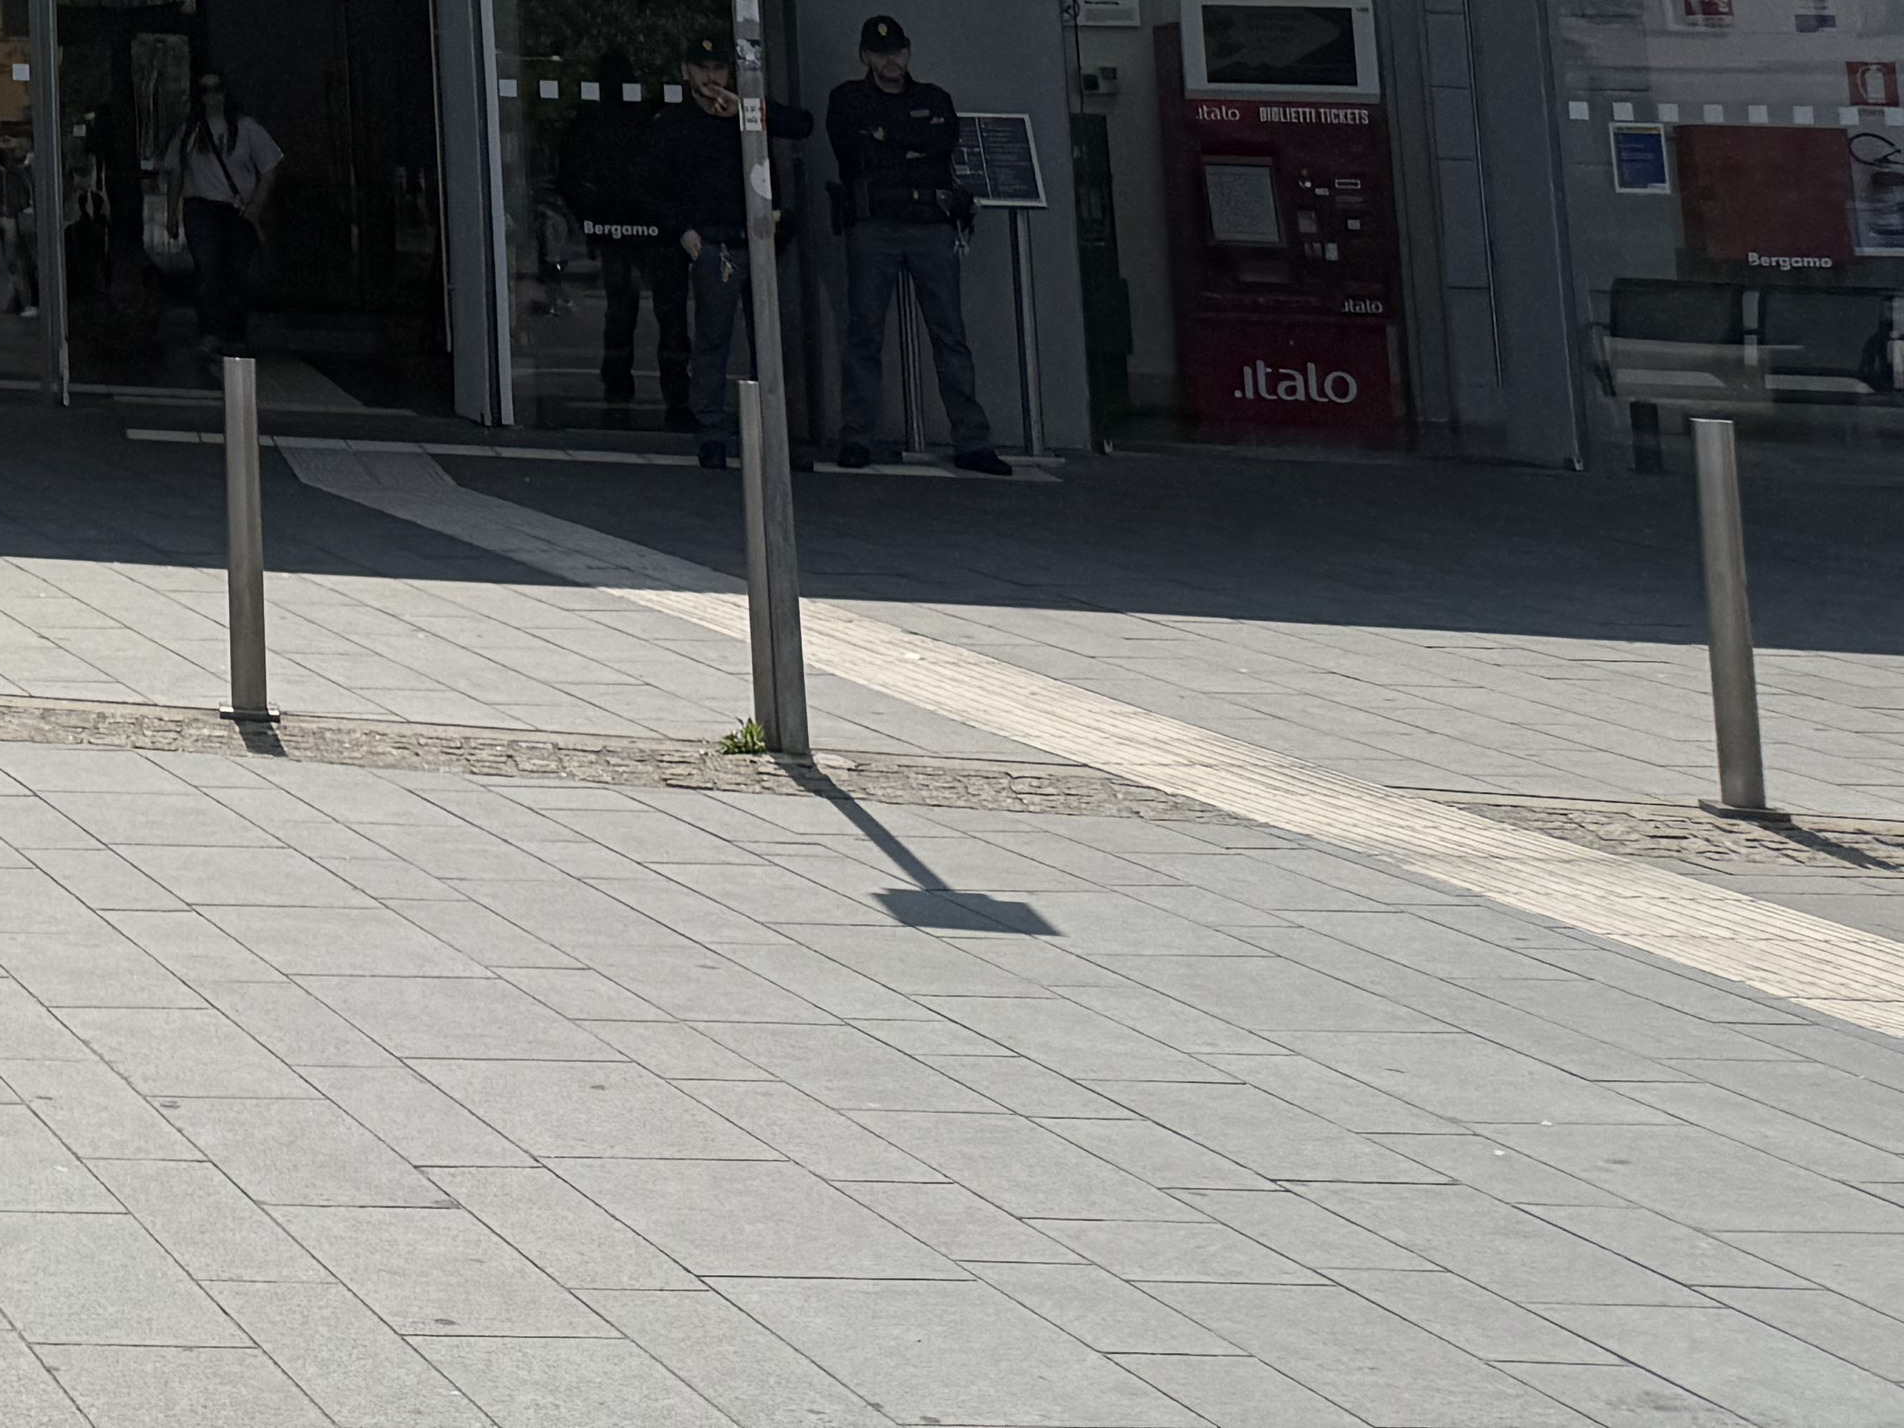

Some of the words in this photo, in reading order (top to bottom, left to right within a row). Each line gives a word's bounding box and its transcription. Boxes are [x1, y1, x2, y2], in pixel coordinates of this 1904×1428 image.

[1258, 106, 1316, 123] BIGLIETTI
[1319, 108, 1369, 125] TICKETS
[583, 220, 659, 239] Bergamo
[1747, 251, 1834, 271] Bergamo
